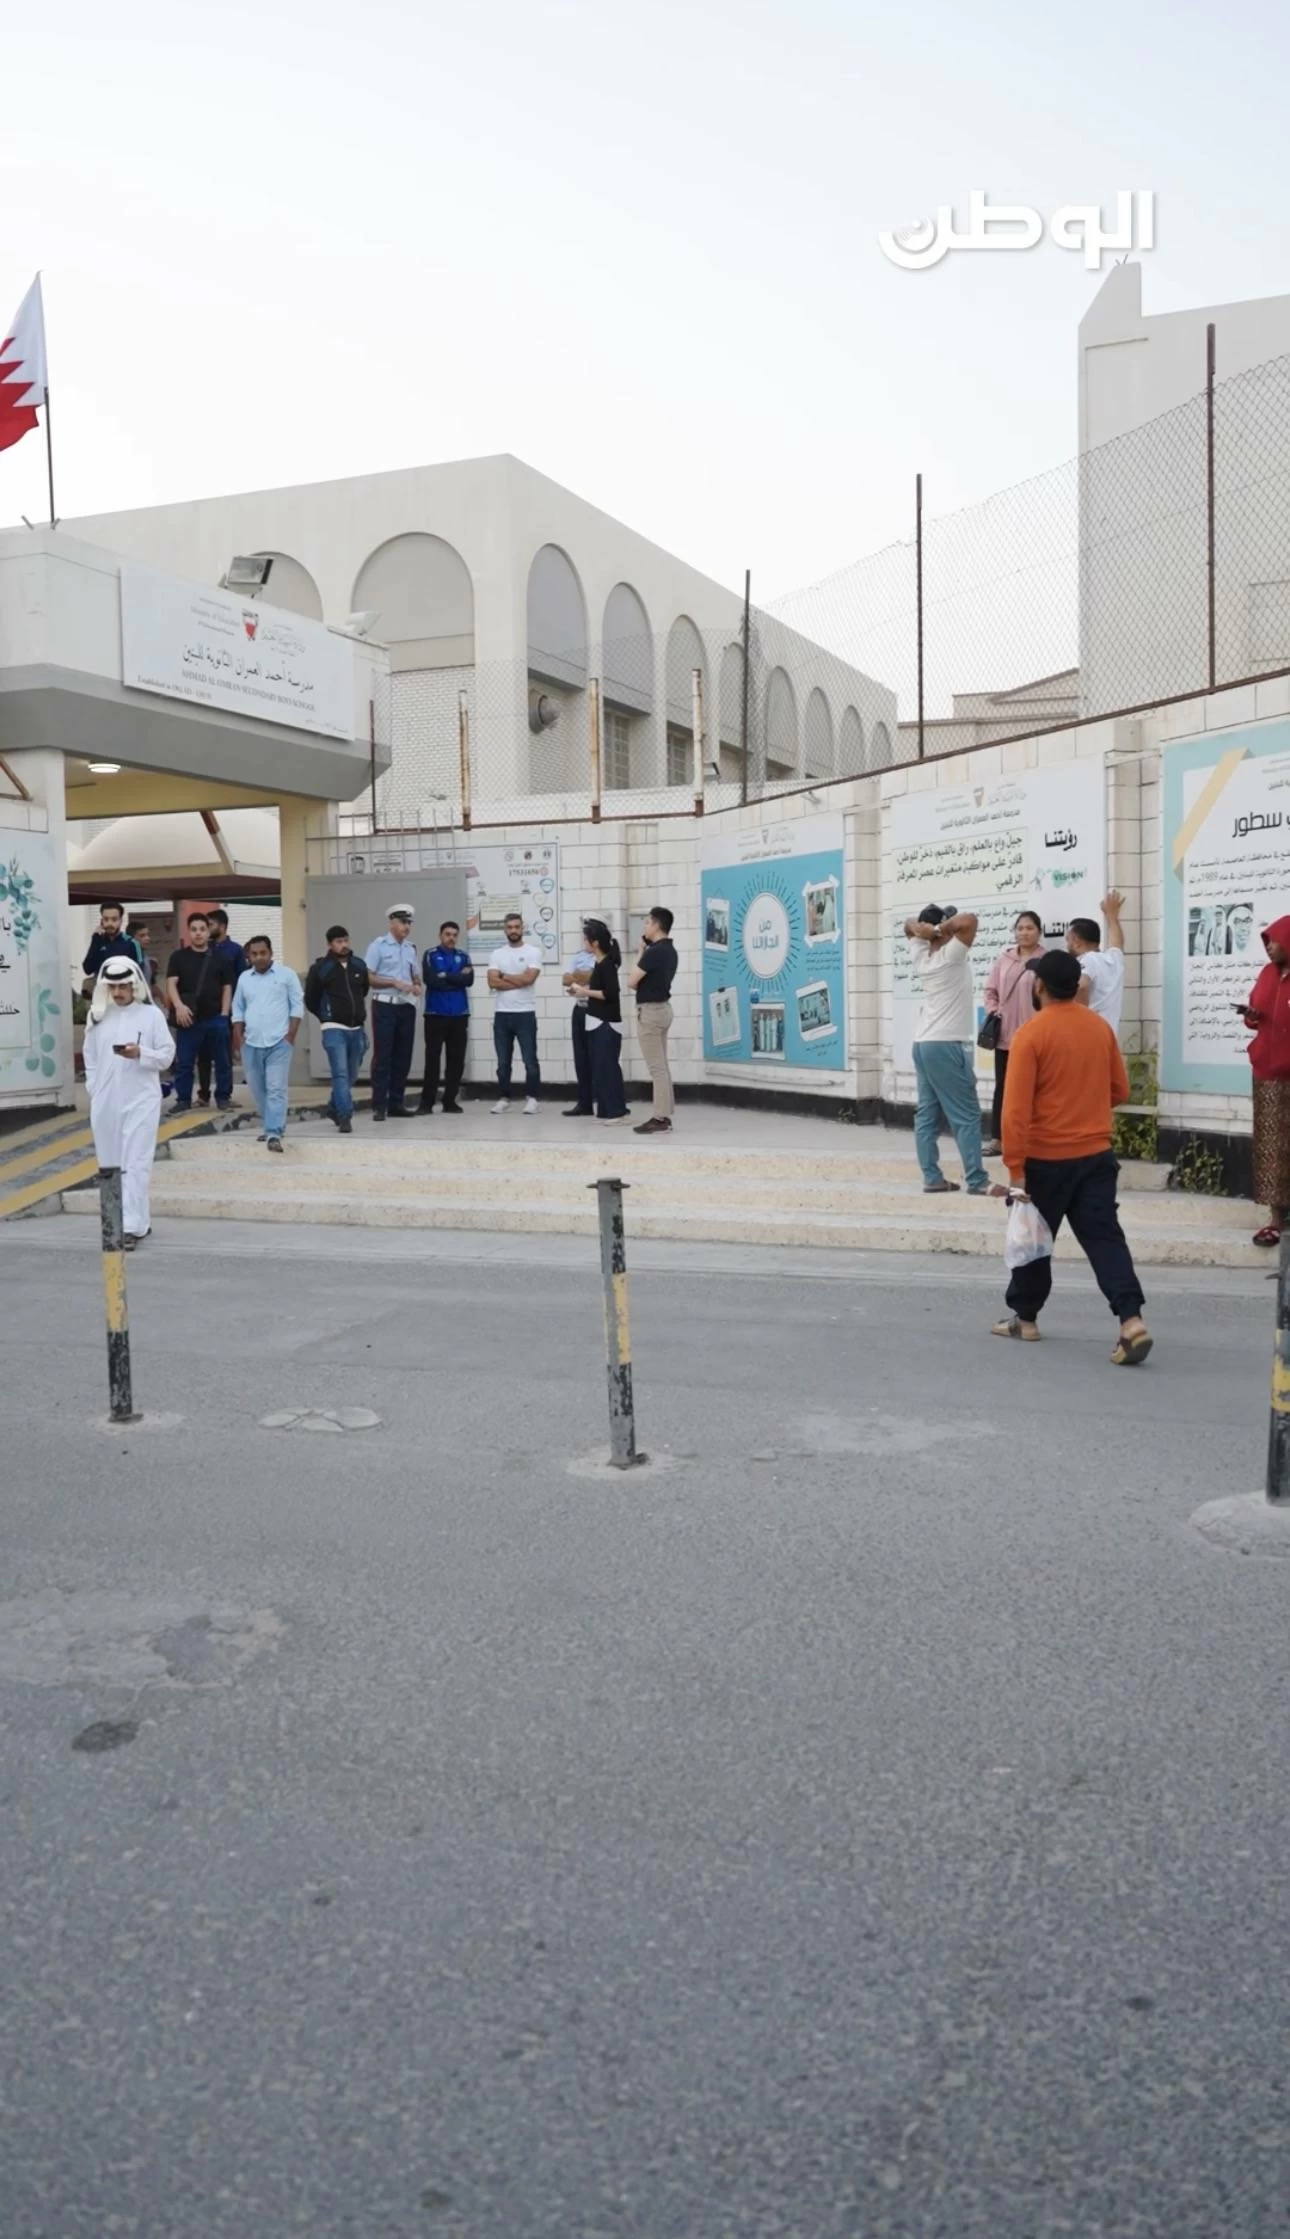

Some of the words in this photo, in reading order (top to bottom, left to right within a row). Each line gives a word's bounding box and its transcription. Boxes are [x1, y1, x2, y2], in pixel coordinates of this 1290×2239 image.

[183, 644, 204, 665] للبنين
[207, 647, 233, 669] الثانوية
[235, 656, 262, 679] العمران
[265, 660, 285, 681] أحمد
[288, 671, 314, 693] مدرسة
[1232, 811, 1282, 838] سطور
[1045, 828, 1078, 851] رؤيتنا
[759, 918, 773, 933] من
